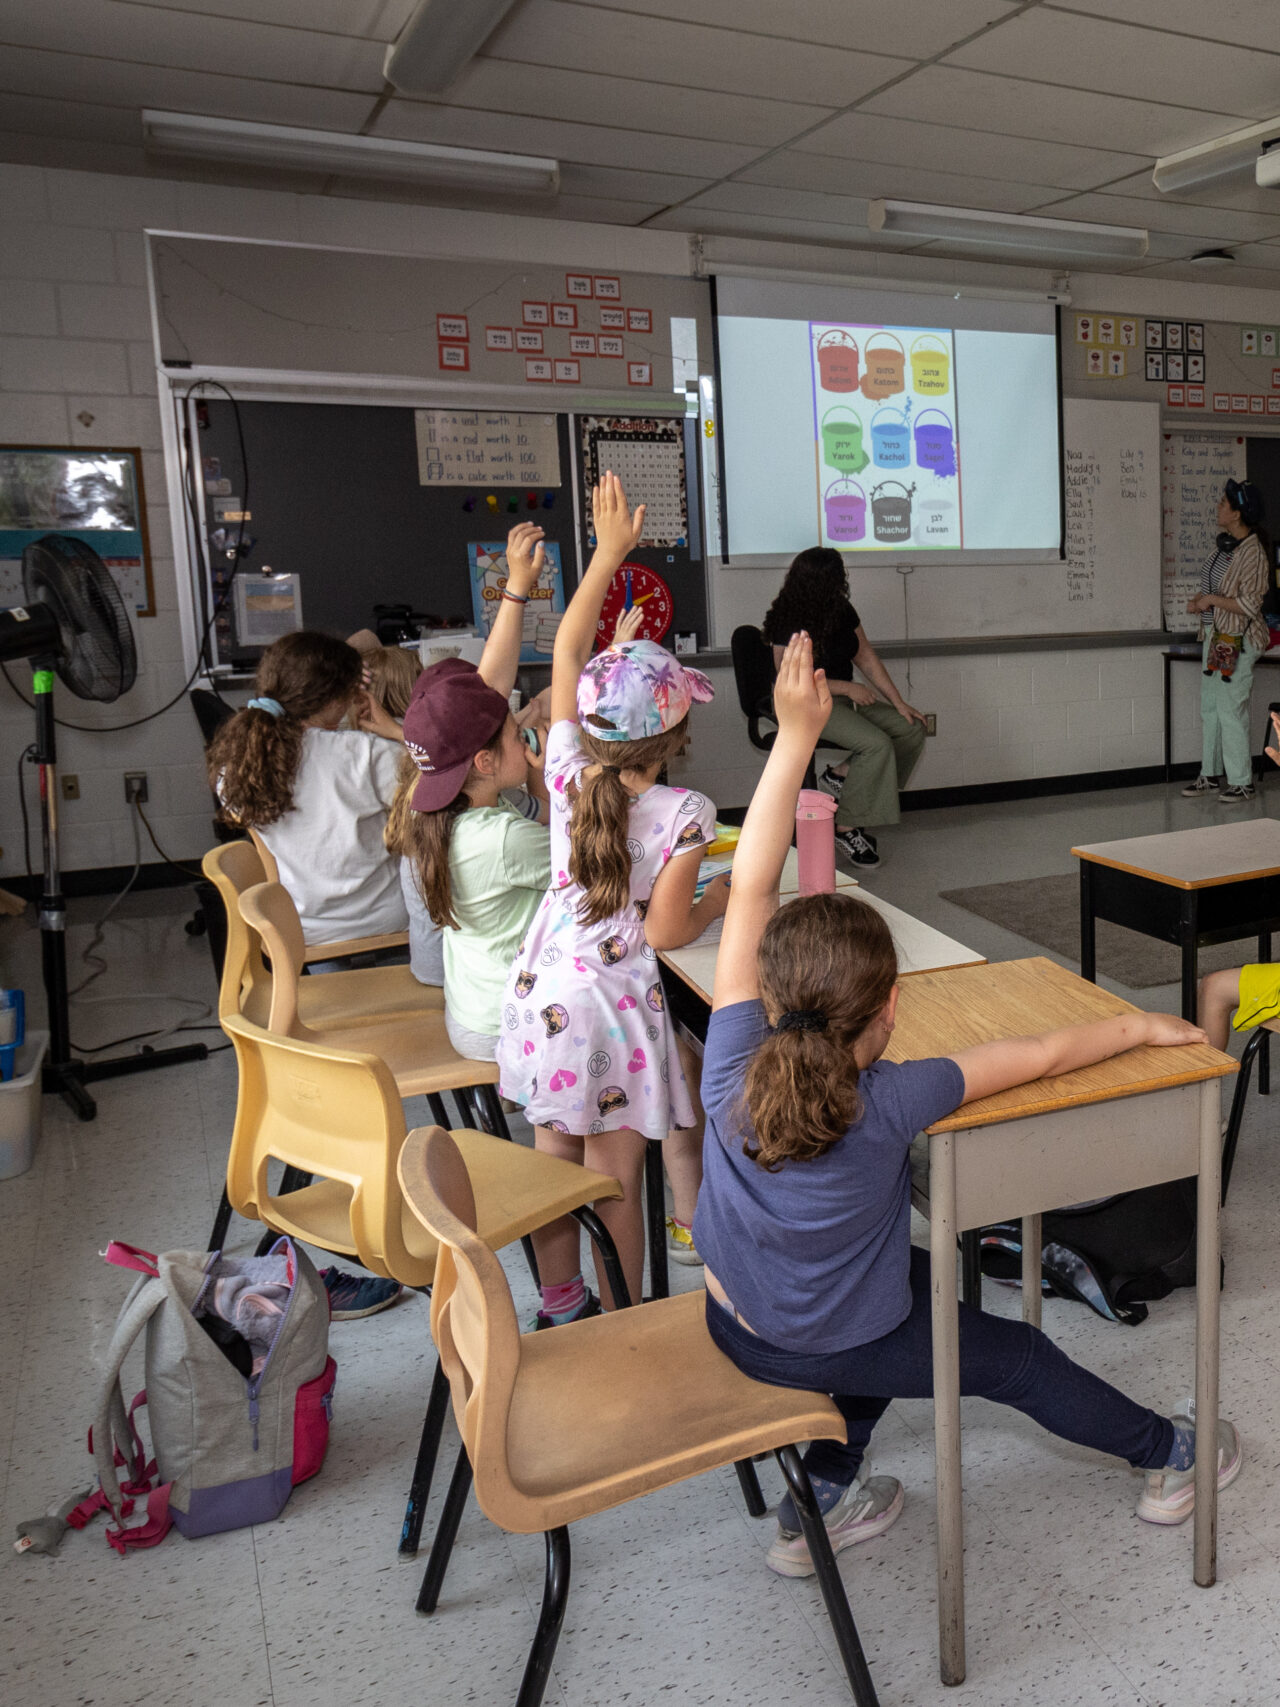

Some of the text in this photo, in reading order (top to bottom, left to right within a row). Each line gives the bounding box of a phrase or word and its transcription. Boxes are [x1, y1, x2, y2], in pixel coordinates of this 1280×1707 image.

[922, 368, 940, 377] צהוב
[874, 378, 900, 387] Katom
[918, 380, 946, 388] Tzahov
[486, 414, 510, 424] worth
[612, 422, 654, 431] Addition
[486, 434, 510, 444] worth
[834, 442, 851, 450] ירוק
[490, 452, 514, 462] worth
[832, 452, 856, 461] Yarok
[878, 452, 906, 462] Kachol
[492, 472, 514, 480] worth
[882, 514, 902, 522] שחור
[931, 512, 943, 523] לבן
[834, 526, 858, 534] Varod
[876, 526, 908, 535] Shachor
[926, 526, 948, 534] Lavan
[641, 576, 646, 586] 1
[654, 588, 661, 598] 2
[659, 602, 666, 611] 3
[598, 620, 605, 630] 8
[654, 618, 662, 628] 4
[643, 630, 650, 640] 5
